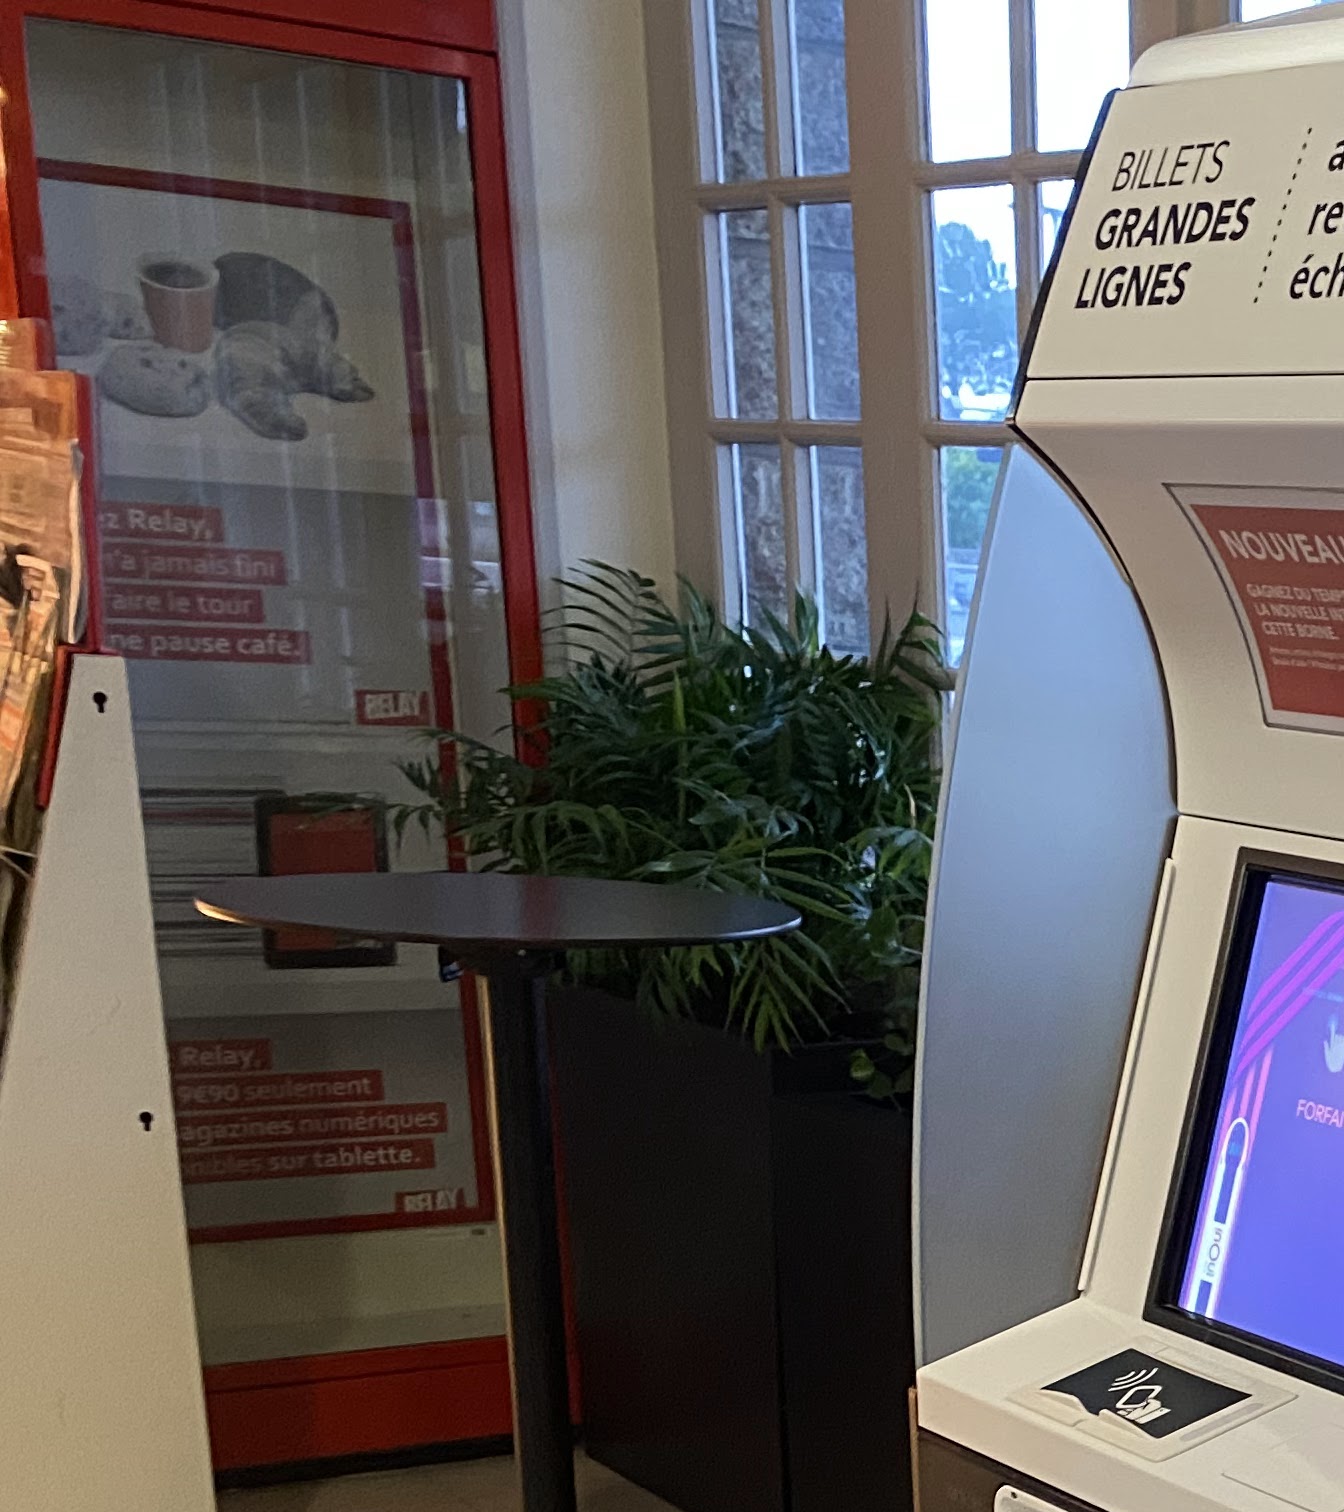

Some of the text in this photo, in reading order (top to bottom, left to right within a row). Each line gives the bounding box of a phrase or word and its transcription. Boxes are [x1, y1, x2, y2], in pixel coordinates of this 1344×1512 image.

[1112, 139, 1231, 192] BILLETS
[1095, 197, 1255, 251] GRANDES
[1074, 261, 1191, 310] LIGNES
[128, 509, 212, 539] Relay,
[142, 552, 228, 578] jamais
[234, 555, 276, 576] fini
[168, 590, 190, 612] le
[199, 596, 252, 615] tour
[1247, 584, 1294, 599] GAGNEZ
[1294, 587, 1311, 601] DU
[1254, 603, 1270, 615] LA
[1270, 604, 1329, 620] NOUVELLE
[1262, 621, 1295, 636] CETTE
[150, 635, 228, 659] pause
[244, 1077, 372, 1099] seulement
[300, 1109, 439, 1134] numériques
[267, 1154, 305, 1170] sur
[313, 1147, 421, 1168] tablette.
